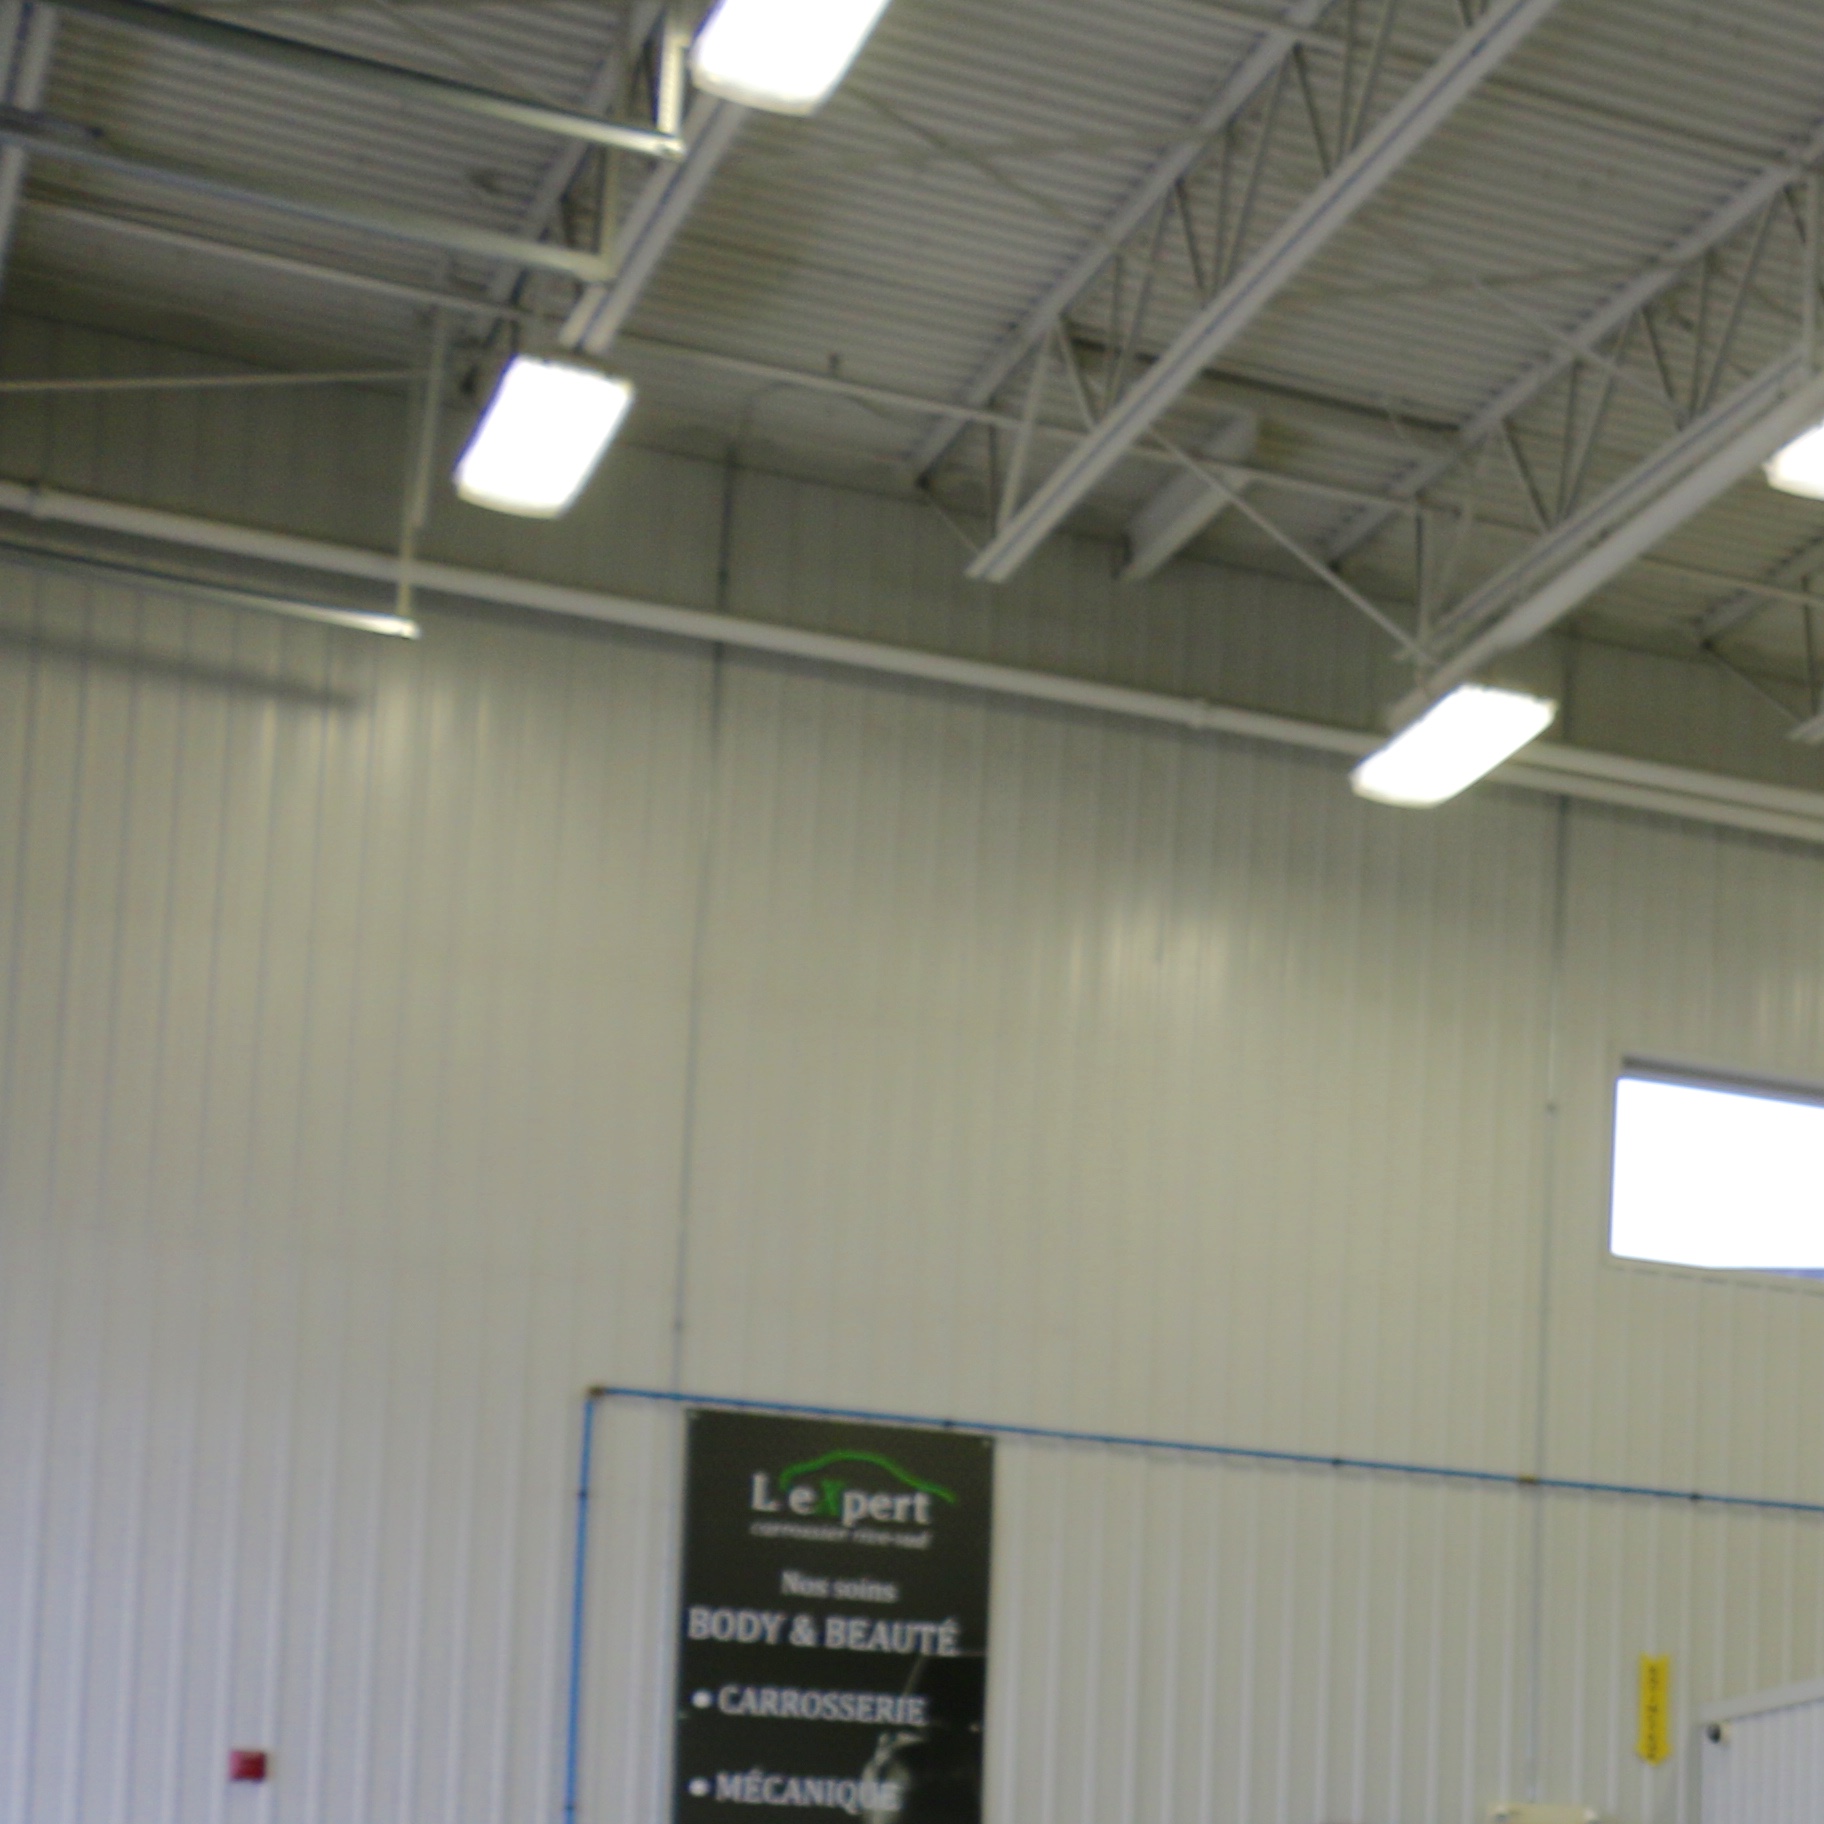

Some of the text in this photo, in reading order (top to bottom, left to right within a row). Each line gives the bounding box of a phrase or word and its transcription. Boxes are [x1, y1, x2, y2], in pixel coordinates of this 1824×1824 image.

[688, 1608, 959, 1655] BODY & BEAUTÉ
[718, 1686, 926, 1724] CARROSSERIE
[716, 1769, 902, 1814] MÉCANIQUE
